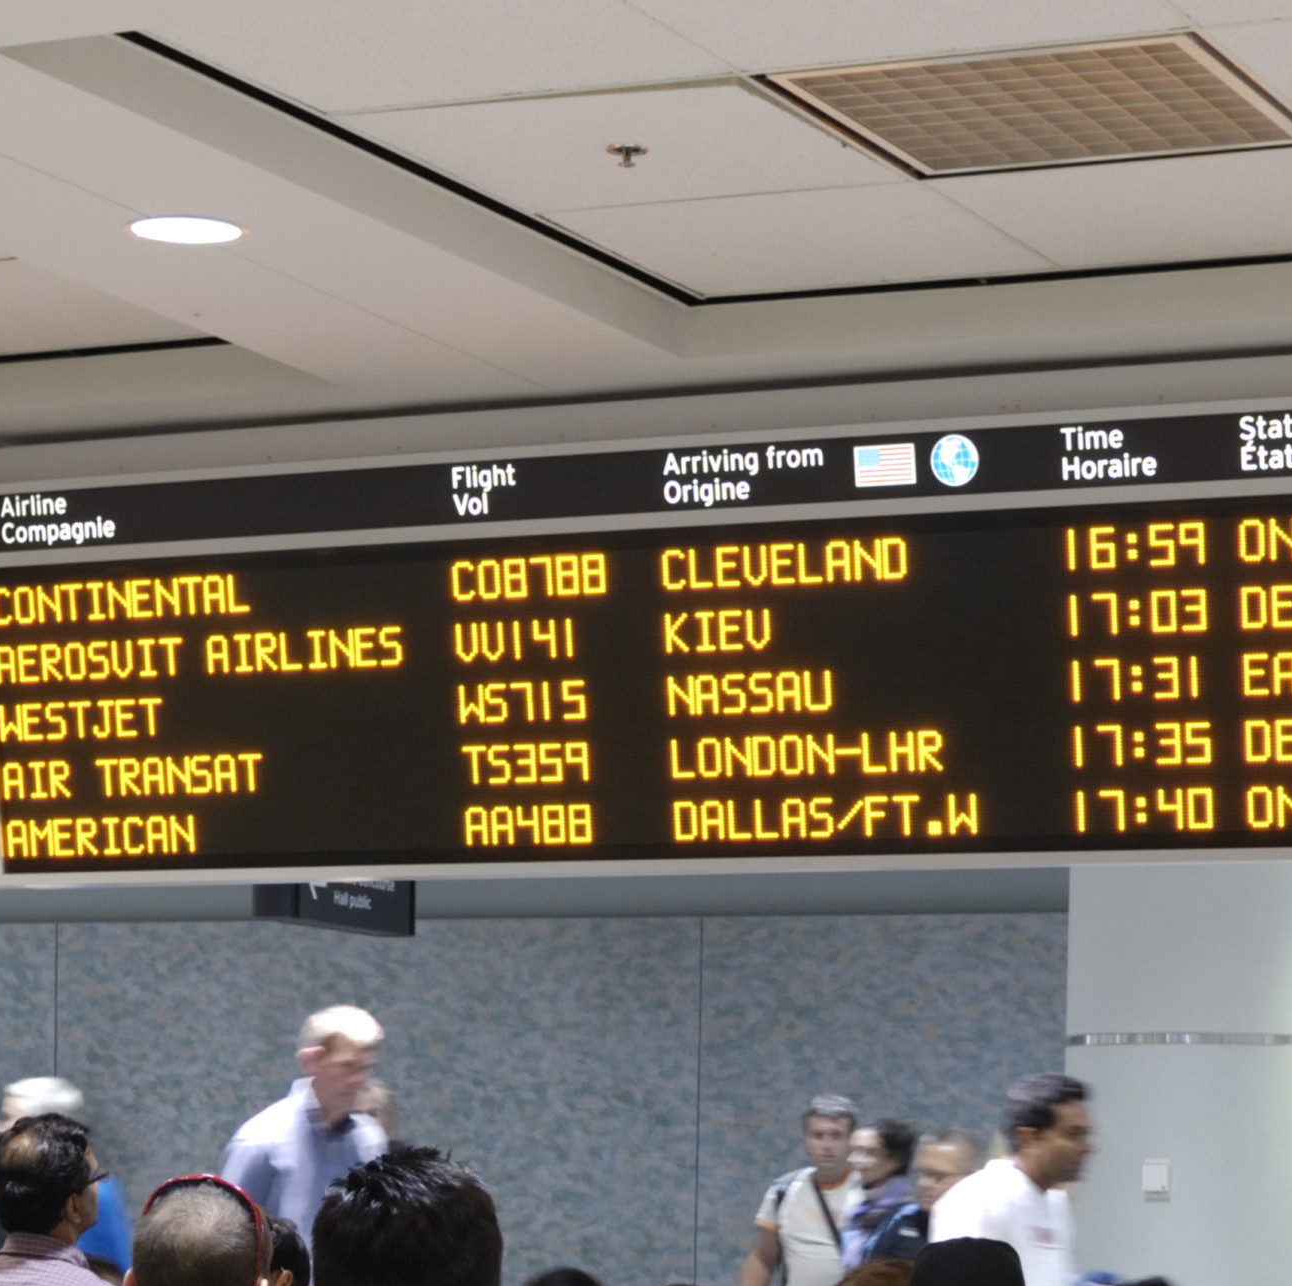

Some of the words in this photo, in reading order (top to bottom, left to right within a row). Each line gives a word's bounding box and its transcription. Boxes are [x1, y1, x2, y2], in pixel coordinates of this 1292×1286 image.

[663, 449, 759, 475] Arriving
[766, 446, 823, 469] from
[1060, 426, 1123, 451] Time
[452, 464, 516, 491] Flight
[1062, 453, 1157, 480] Horaire
[1, 494, 67, 517] Airline
[453, 493, 489, 515] Vol
[664, 478, 750, 507] Origine
[2, 516, 115, 545] Compagnie
[1067, 522, 1205, 570] 16:59
[451, 553, 606, 601] CO8788
[661, 537, 907, 590] CLEVELAND
[664, 609, 771, 653] KIEV
[1069, 589, 1207, 636] 17:03
[206, 626, 403, 674] AIRLINES
[455, 618, 573, 662] VV141
[667, 670, 832, 716] NASSAU
[1072, 656, 1198, 702] 17:31
[458, 680, 586, 724] WS715
[461, 742, 589, 784] TS359
[670, 730, 943, 779] LONDON-LHR
[1074, 721, 1212, 767] 17:35
[2, 760, 71, 800] AIR
[95, 753, 262, 797] TRANSAT
[465, 804, 592, 846] AA488
[673, 793, 978, 841] DALLAS/FT.W
[1077, 787, 1214, 832] 17:40
[6, 815, 196, 858] AMERICAN
